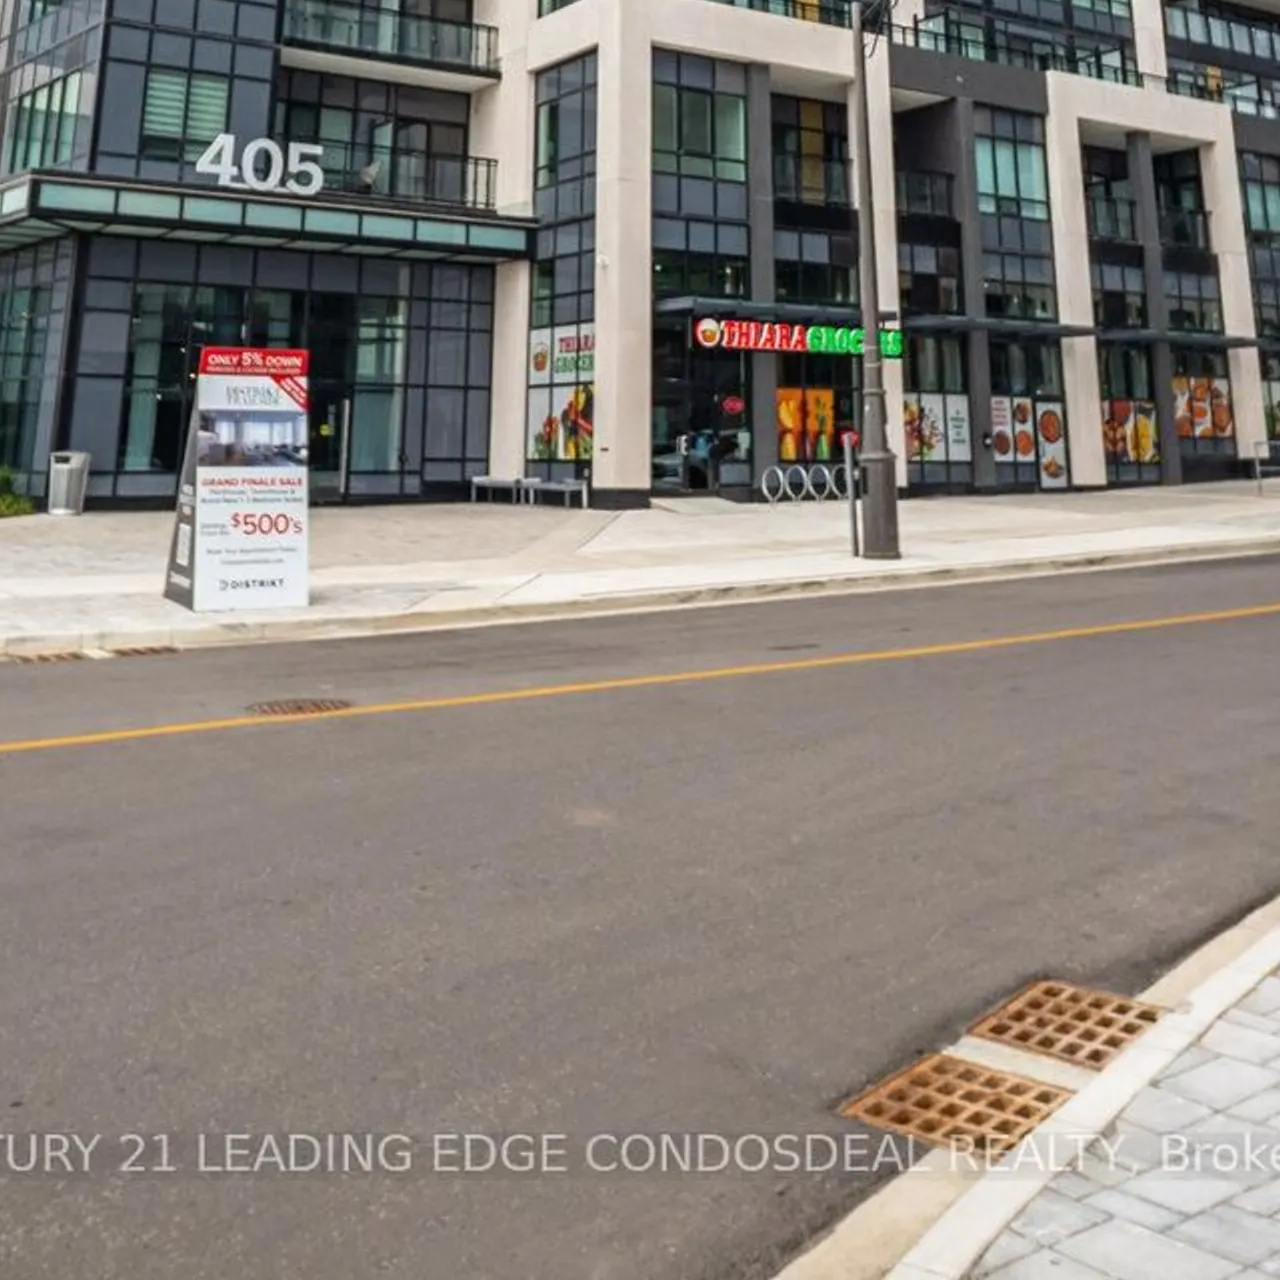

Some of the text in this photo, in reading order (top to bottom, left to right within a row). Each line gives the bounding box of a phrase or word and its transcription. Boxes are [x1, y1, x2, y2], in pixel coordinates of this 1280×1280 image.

[196, 133, 324, 196] 405
[208, 351, 303, 368] ONLY 5% DOWN
[201, 477, 302, 487] GRAND FINALE SALE
